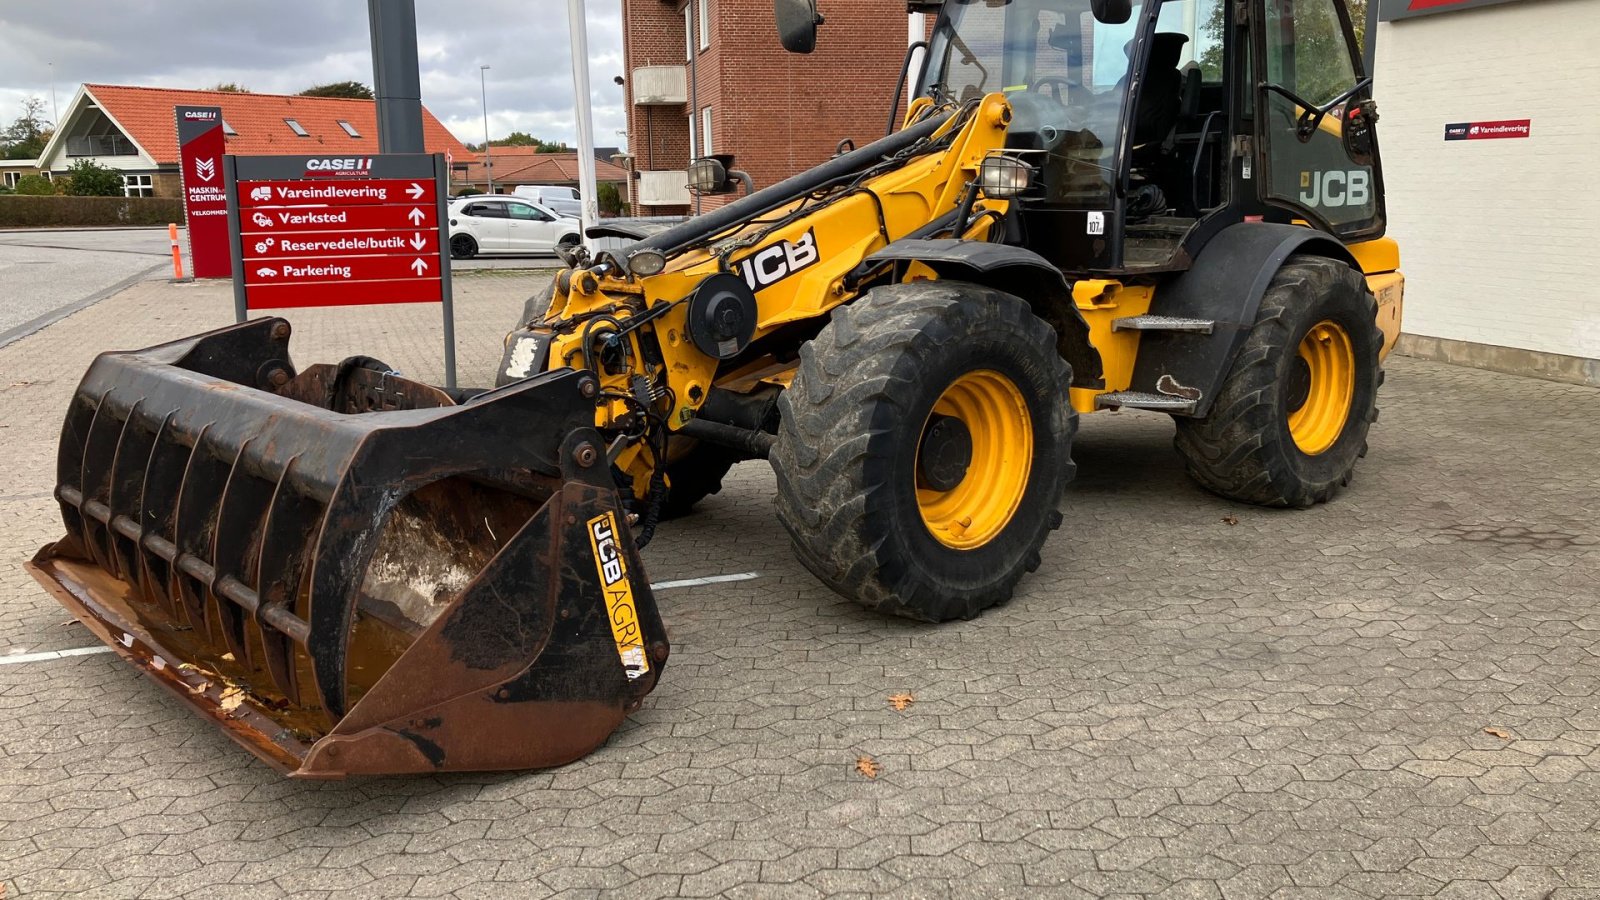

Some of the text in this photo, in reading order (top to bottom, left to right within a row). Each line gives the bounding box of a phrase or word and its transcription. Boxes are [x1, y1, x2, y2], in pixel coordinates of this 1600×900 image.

[184, 111, 209, 119] CASE
[1480, 125, 1528, 133] Vareindlevering
[306, 158, 356, 171] CASE
[188, 186, 219, 195] MASKIN
[277, 186, 387, 199] Vareindlevering
[1299, 170, 1369, 208] JCB
[189, 194, 227, 202] CENTRUM
[278, 211, 347, 225] Værksted
[1089, 221, 1099, 232] 107
[281, 236, 406, 252] Reservedele/butik
[283, 264, 352, 279] Parkering
[593, 523, 623, 585] JCB
